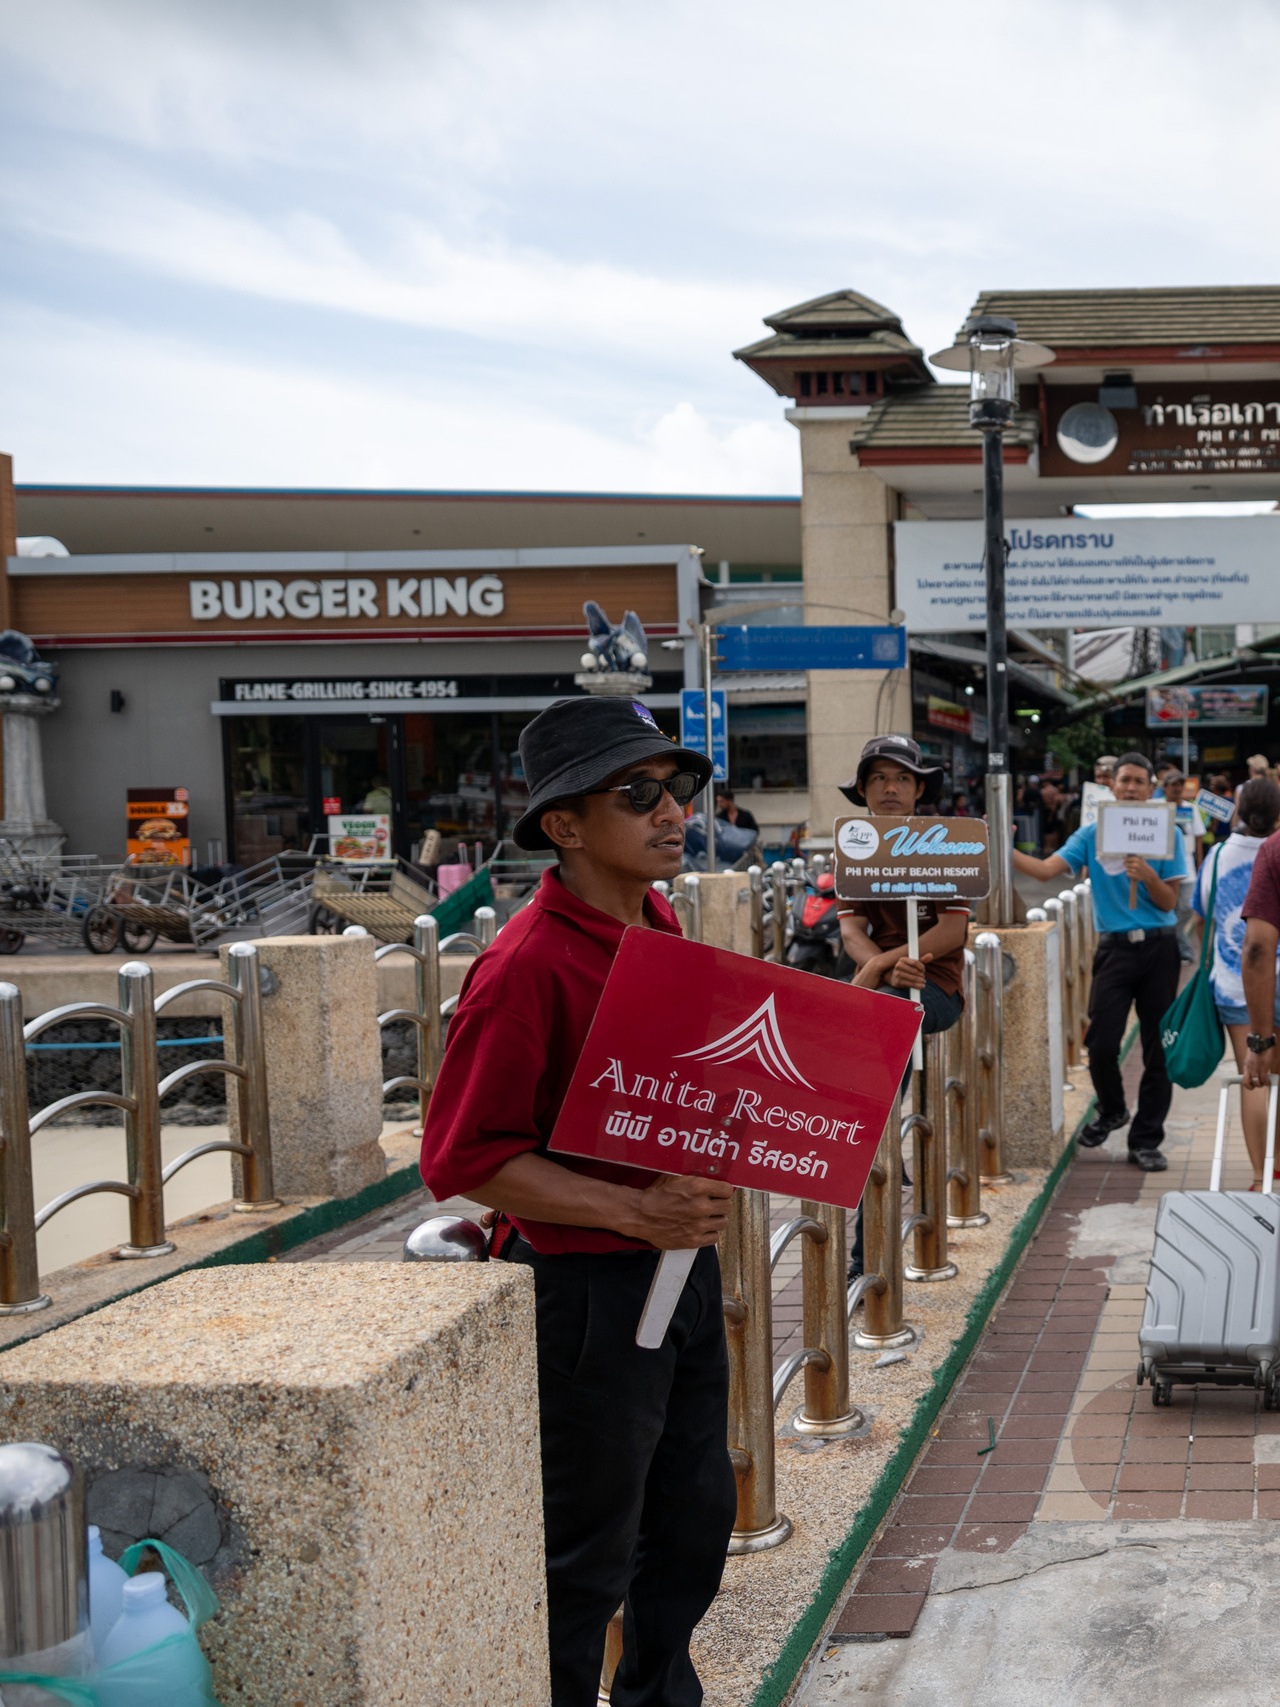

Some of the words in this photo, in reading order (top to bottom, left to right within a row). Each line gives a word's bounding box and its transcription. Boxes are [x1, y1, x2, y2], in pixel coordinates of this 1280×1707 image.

[1009, 529, 1114, 551] โปรดทราบ
[189, 577, 380, 620] BURGER
[386, 574, 505, 618] KING
[1122, 816, 1140, 827] Phi
[1141, 816, 1158, 827] Phi
[883, 823, 986, 858] Welcome
[1127, 832, 1155, 842] Hotel
[845, 867, 862, 877] PHI
[863, 867, 880, 877] PHI
[881, 867, 907, 877] CLIFF
[909, 867, 942, 877] BEACH
[943, 867, 980, 877] RESORT
[589, 1056, 717, 1114] Anita
[728, 1086, 866, 1146] Resort
[604, 1110, 653, 1141] พีพี
[657, 1125, 740, 1162] อานีต้า
[747, 1139, 830, 1180] รีสอร์ท
